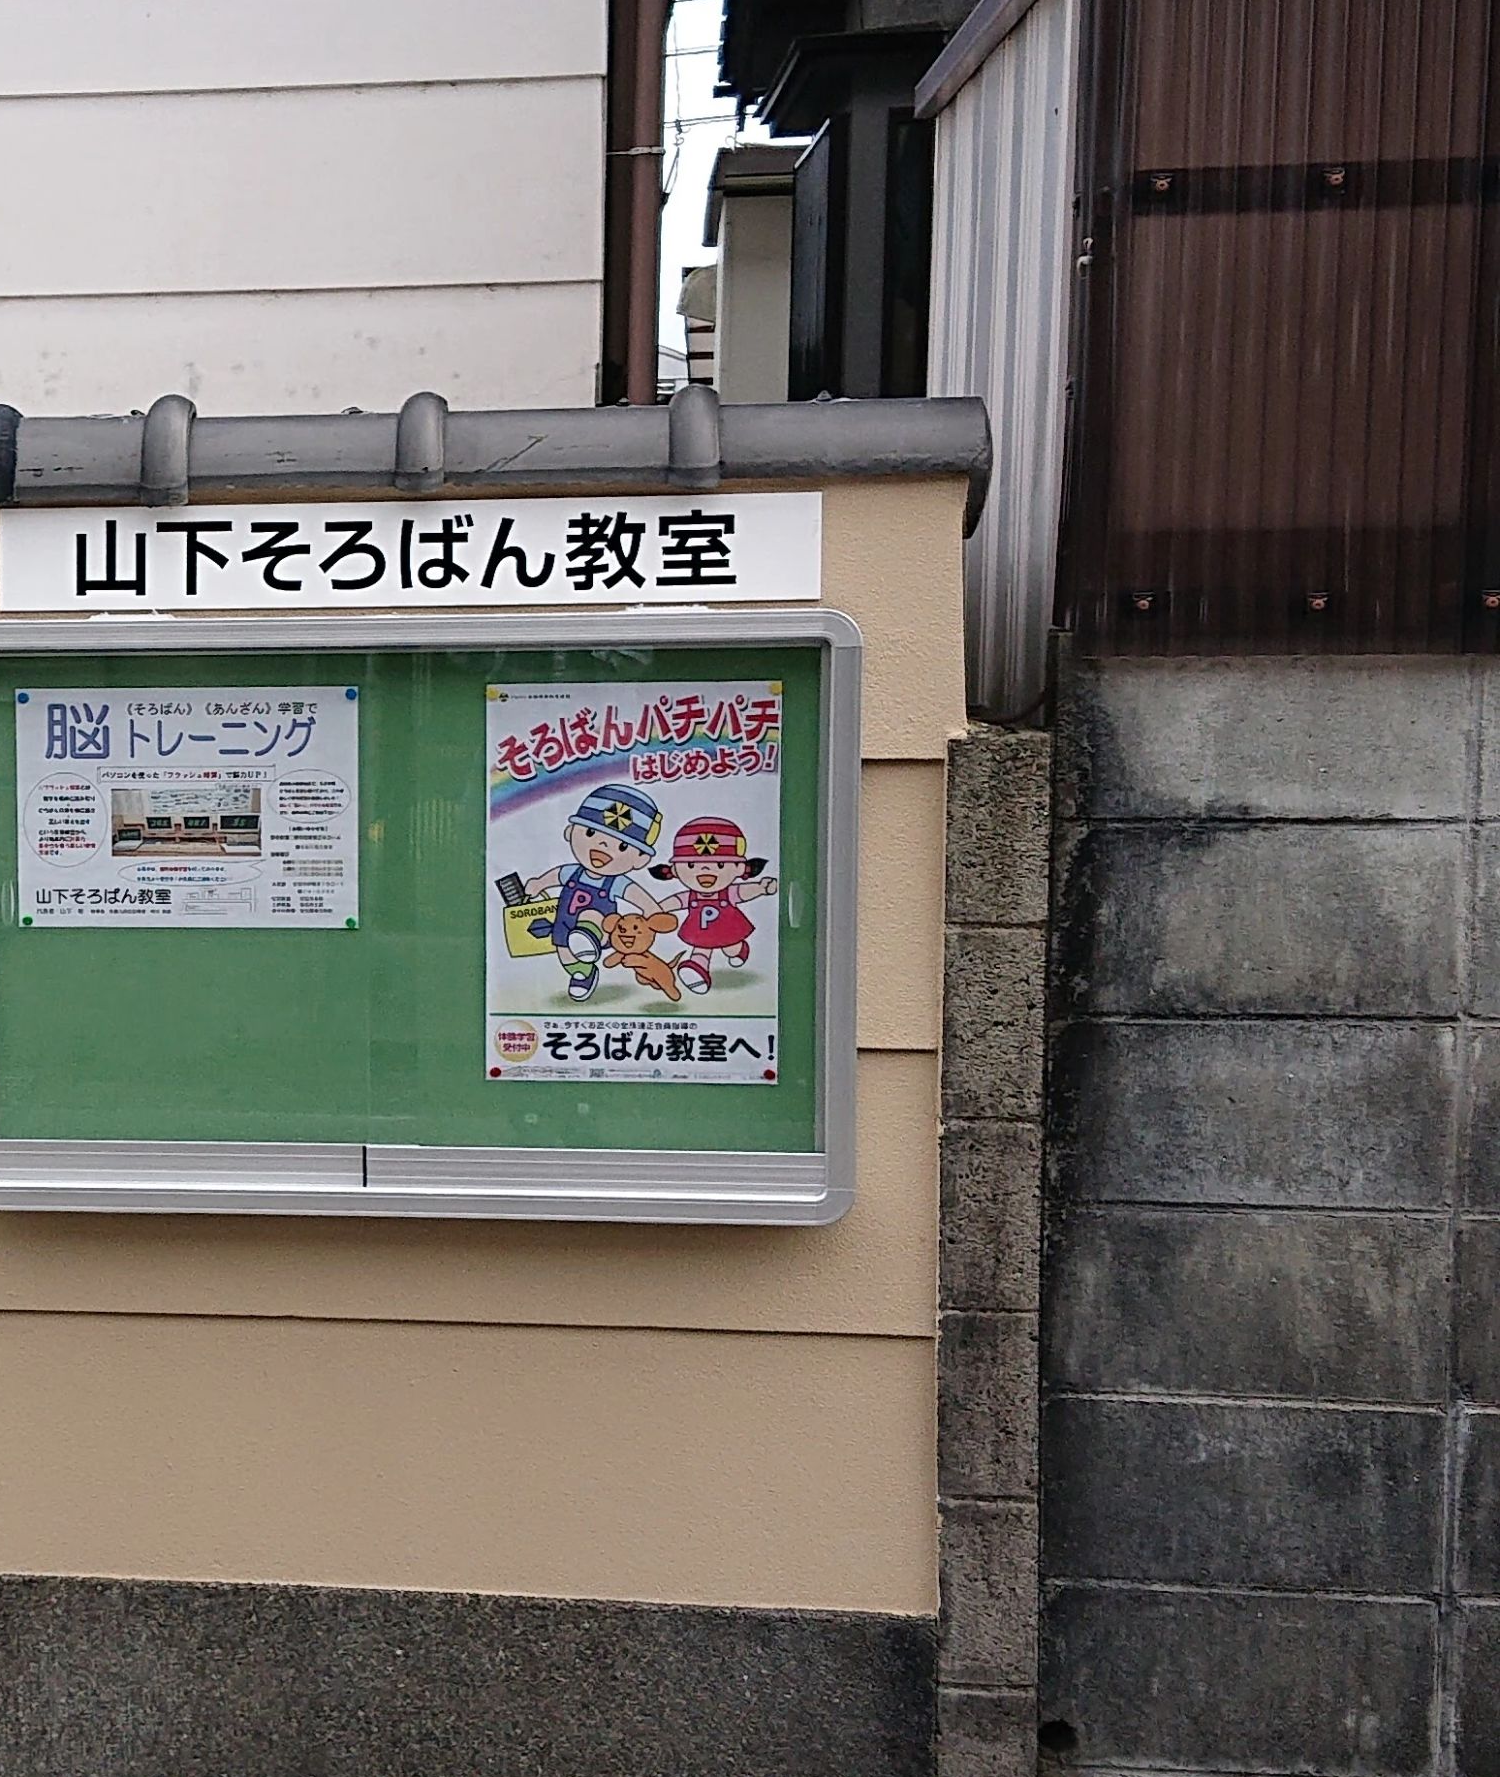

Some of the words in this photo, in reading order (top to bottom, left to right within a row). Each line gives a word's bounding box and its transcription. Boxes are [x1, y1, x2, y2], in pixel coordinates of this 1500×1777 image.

[74, 510, 738, 597] 山下そろばん教室
[496, 694, 780, 778] そろばんパチパチ
[543, 1032, 775, 1062] そろばん教室へ!
